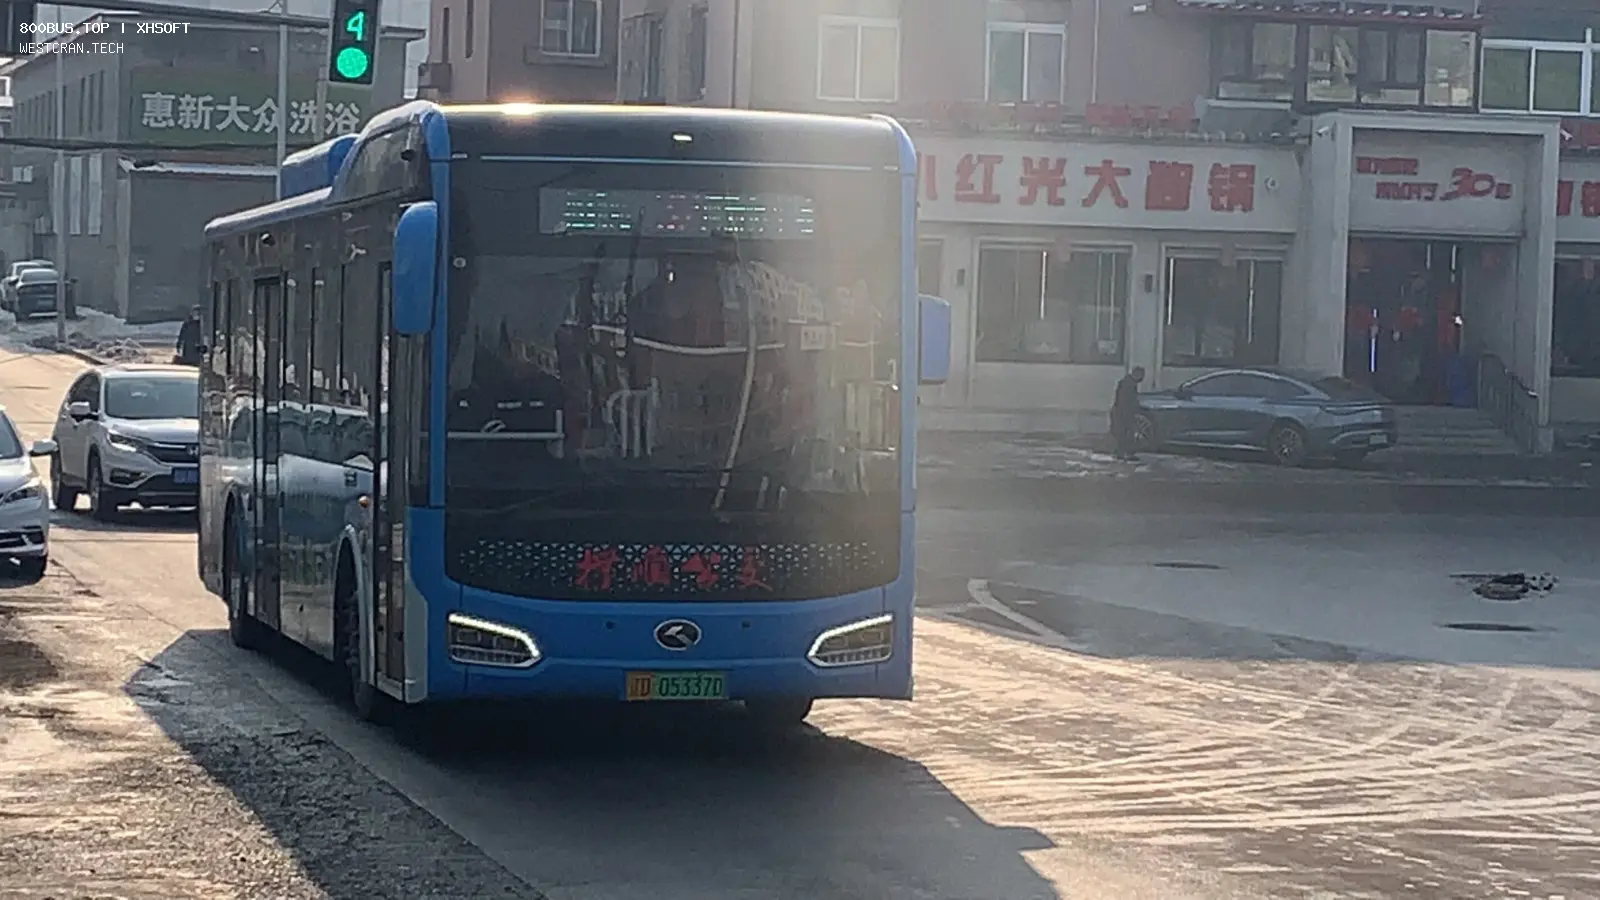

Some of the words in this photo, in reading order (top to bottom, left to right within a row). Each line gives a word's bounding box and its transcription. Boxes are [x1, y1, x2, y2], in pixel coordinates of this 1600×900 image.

[346, 11, 364, 41] 4
[142, 92, 360, 136] 惠新大众洗浴
[659, 676, 723, 697] 05337D
